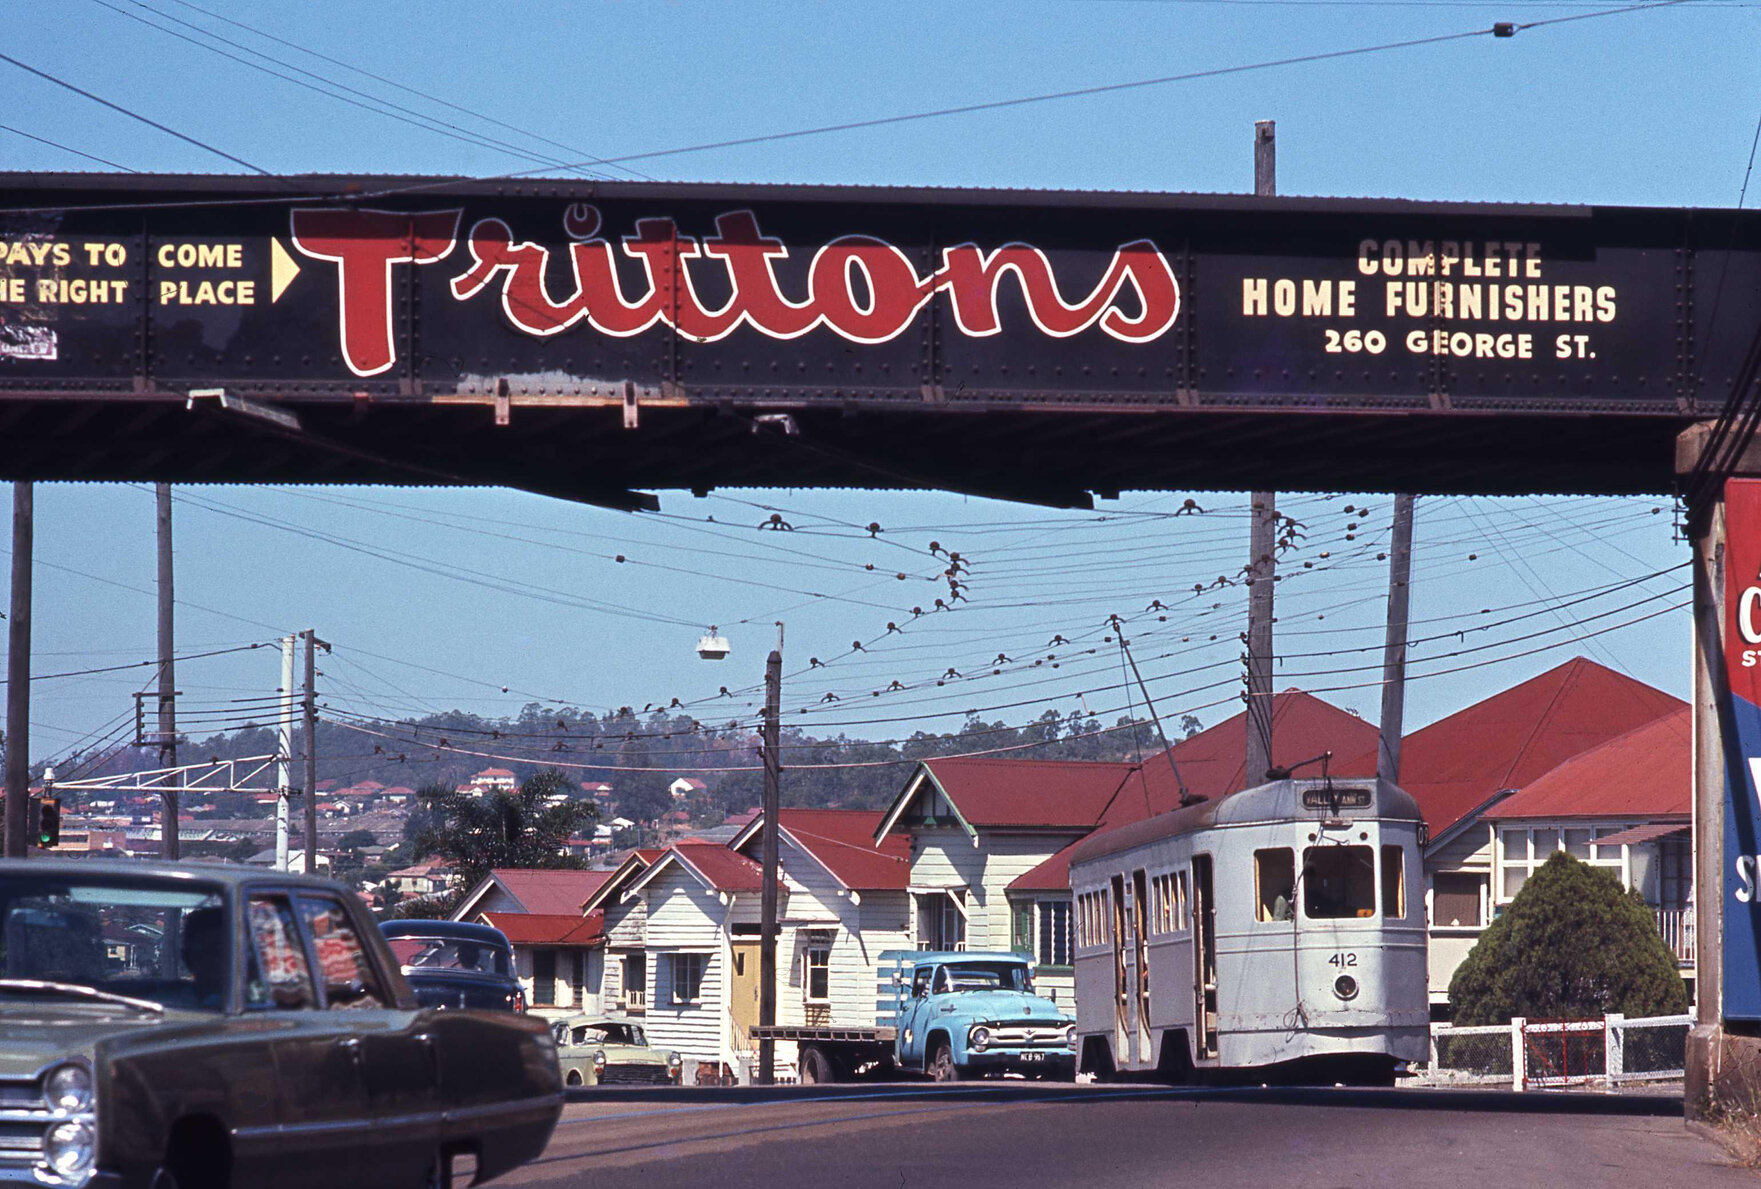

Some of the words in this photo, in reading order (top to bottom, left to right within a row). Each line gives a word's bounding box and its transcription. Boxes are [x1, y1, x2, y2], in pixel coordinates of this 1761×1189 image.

[84, 243, 127, 267] TO
[157, 243, 243, 268] COME
[1358, 239, 1541, 277] COMPLETE
[37, 279, 129, 304] RIGHT
[160, 280, 256, 305] PLACE
[289, 205, 1182, 378] Trittons
[1242, 278, 1356, 317] HOME
[1386, 281, 1617, 323] FURNISHERS
[1324, 329, 1387, 355] 260
[1405, 330, 1533, 358] GEORGE
[1555, 335, 1597, 359] ST.
[1305, 793, 1340, 805] VALLY
[1328, 952, 1358, 968] 412
